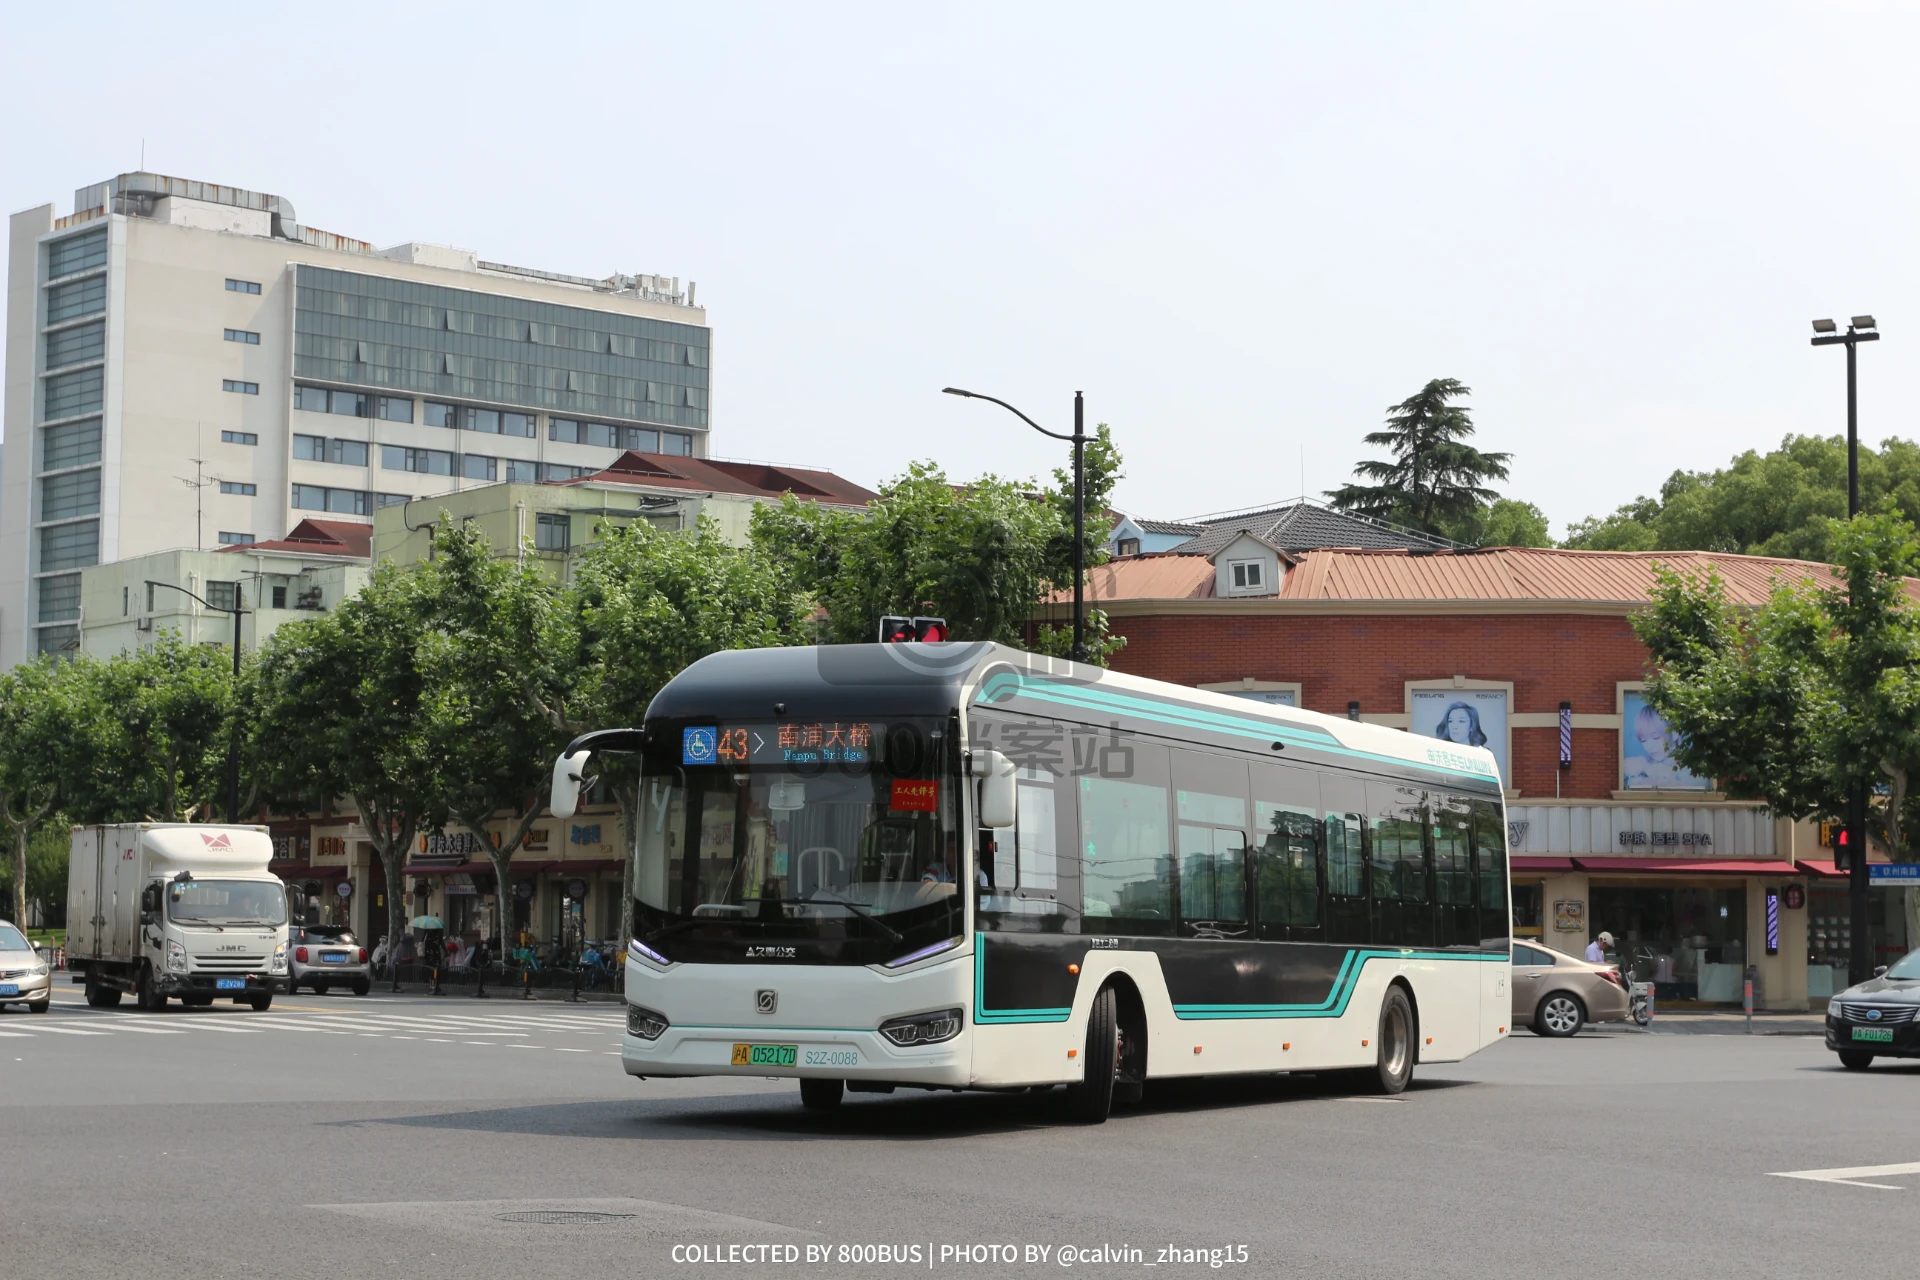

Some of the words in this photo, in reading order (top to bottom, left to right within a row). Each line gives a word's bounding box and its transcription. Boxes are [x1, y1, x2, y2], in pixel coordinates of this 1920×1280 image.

[778, 723, 871, 748] 南浦大桥
[718, 729, 748, 759] 43
[784, 749, 817, 762] Nanpu
[823, 747, 863, 761] Bridge
[1620, 832, 1646, 845] 护肤
[1652, 832, 1679, 845] 造型
[1683, 833, 1712, 846] SPA
[216, 944, 247, 952] JMC
[805, 1051, 858, 1065] S2Z-0088
